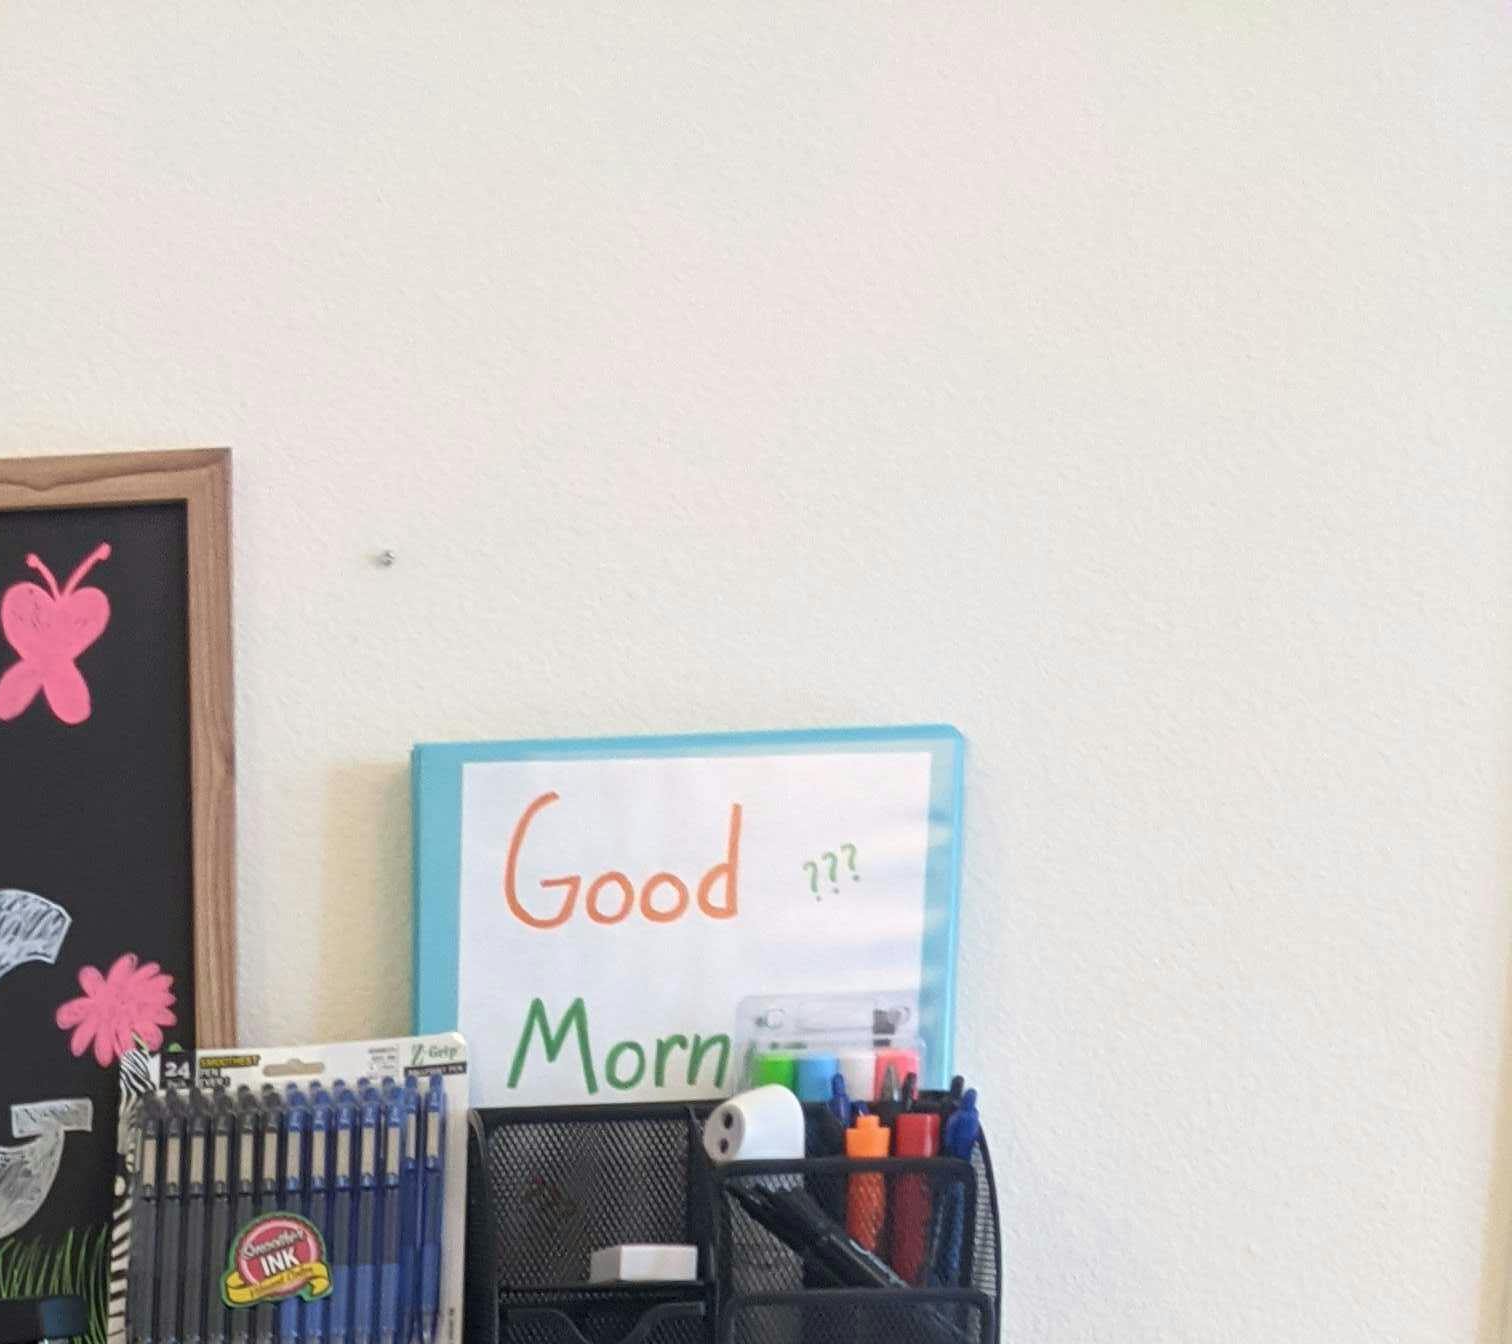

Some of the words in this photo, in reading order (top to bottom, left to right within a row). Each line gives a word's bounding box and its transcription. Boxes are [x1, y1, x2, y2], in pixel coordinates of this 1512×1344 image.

[503, 791, 743, 929] Good
[802, 842, 860, 903] ???
[165, 1060, 191, 1079] 24
[260, 1247, 301, 1277] INK
